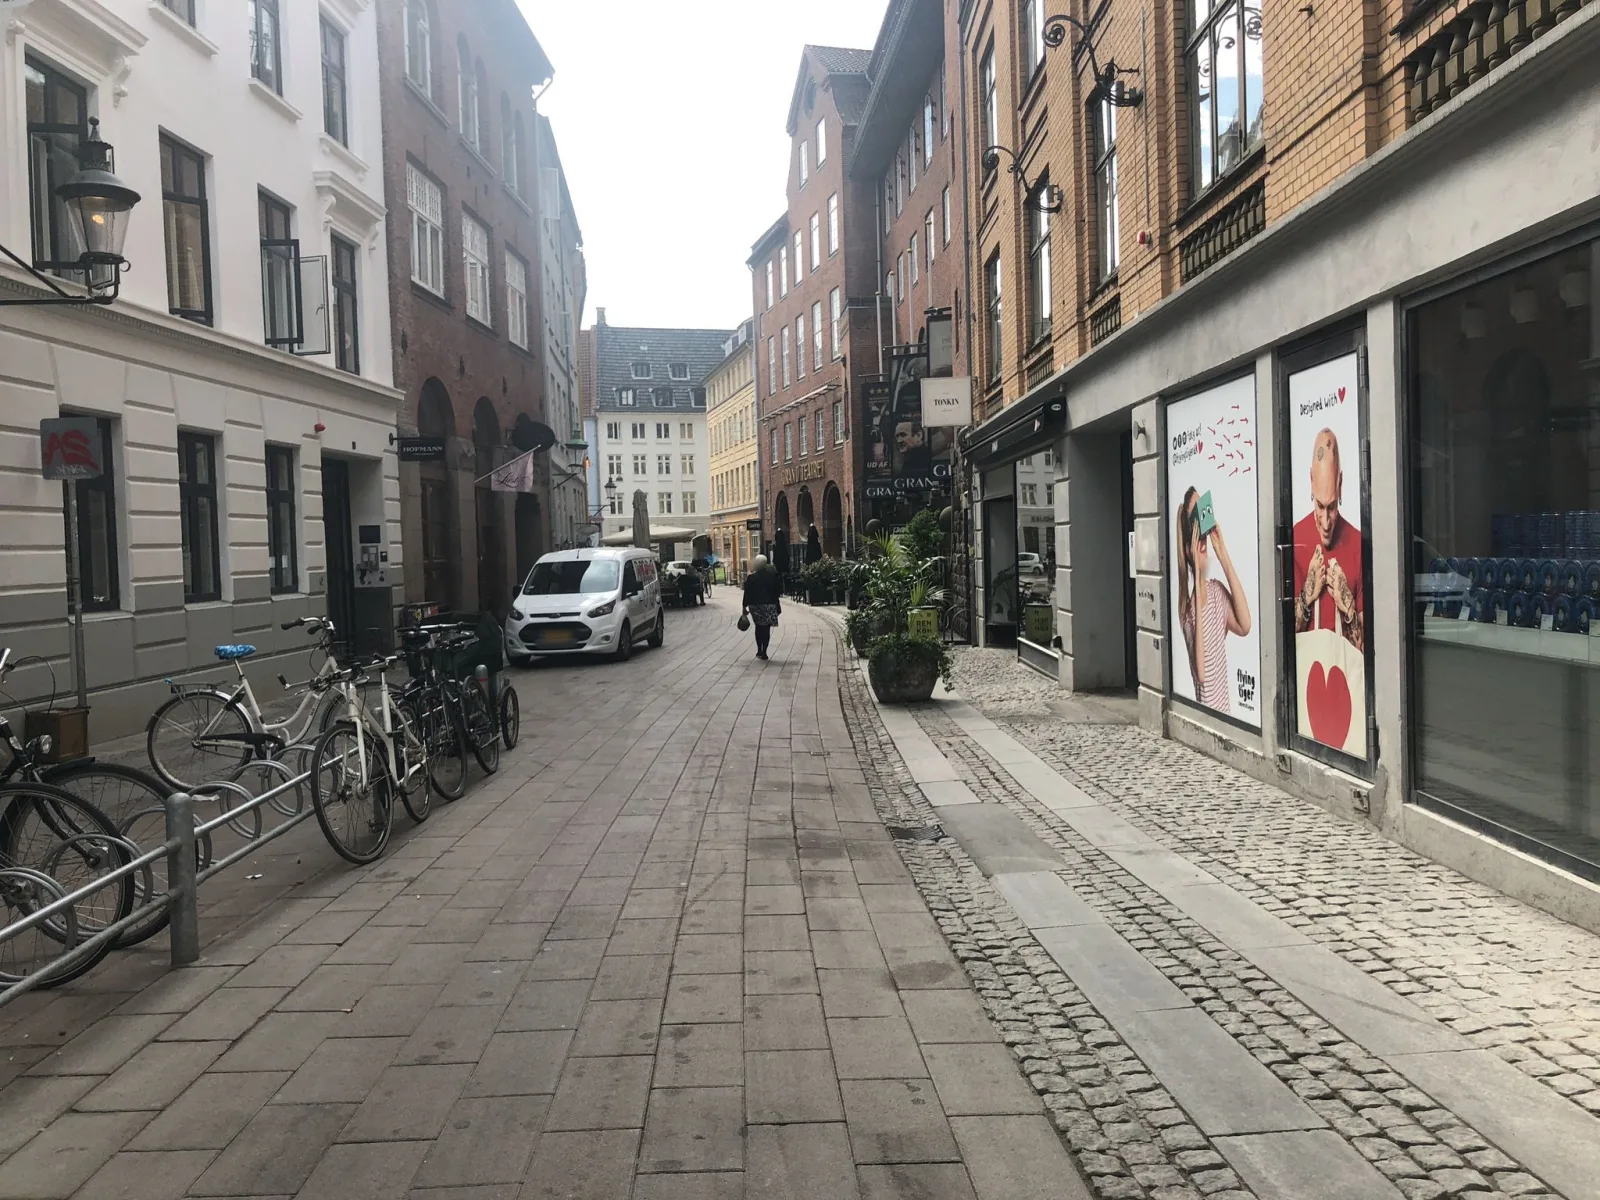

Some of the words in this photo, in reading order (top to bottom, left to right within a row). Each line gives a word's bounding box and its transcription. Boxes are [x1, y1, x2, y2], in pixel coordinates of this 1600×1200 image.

[933, 398, 959, 406] TONKIN
[1300, 396, 1323, 418] Designed
[1324, 391, 1338, 408] with
[780, 464, 801, 485] GRAND
[1237, 668, 1255, 690] flying
[1238, 684, 1254, 702] tiger
